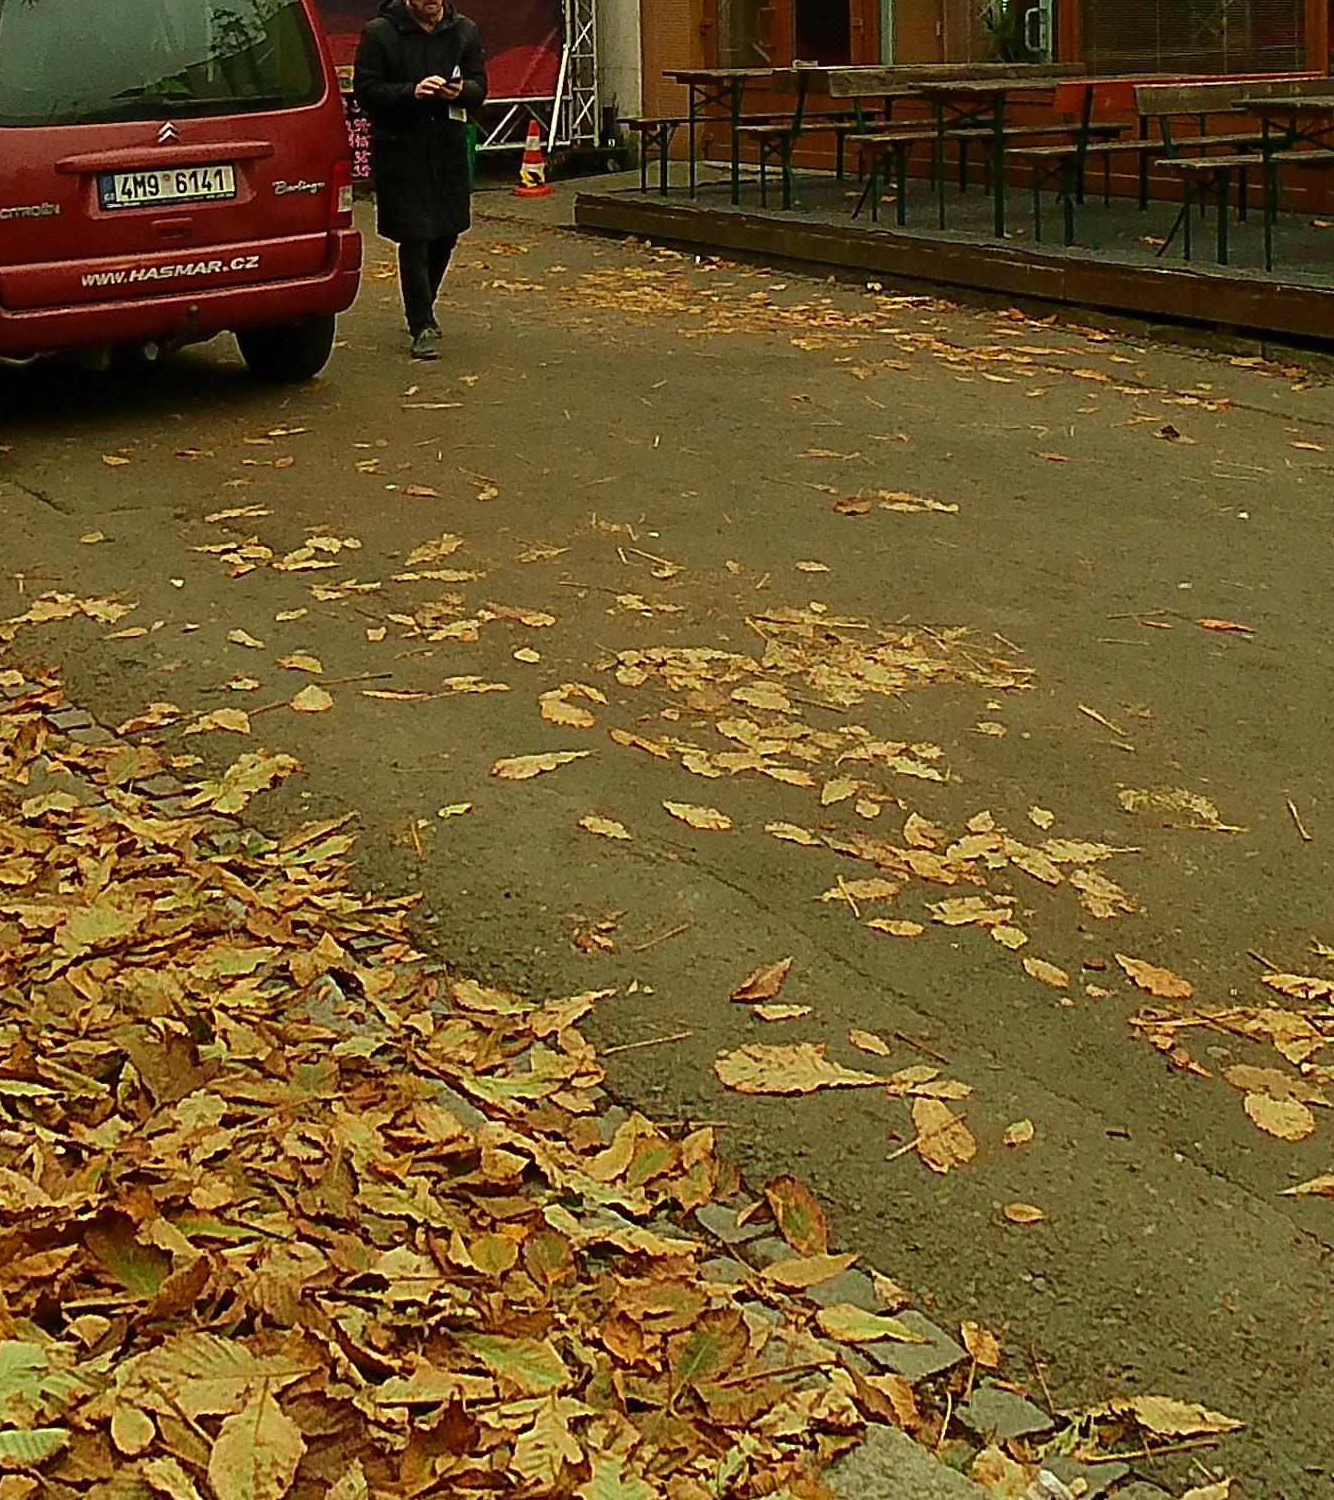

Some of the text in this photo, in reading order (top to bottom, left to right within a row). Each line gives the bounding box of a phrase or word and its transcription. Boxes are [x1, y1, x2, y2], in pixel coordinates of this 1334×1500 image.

[119, 169, 225, 200] 4M9 6141
[81, 256, 260, 287] WWW.HASMAR.CZ
